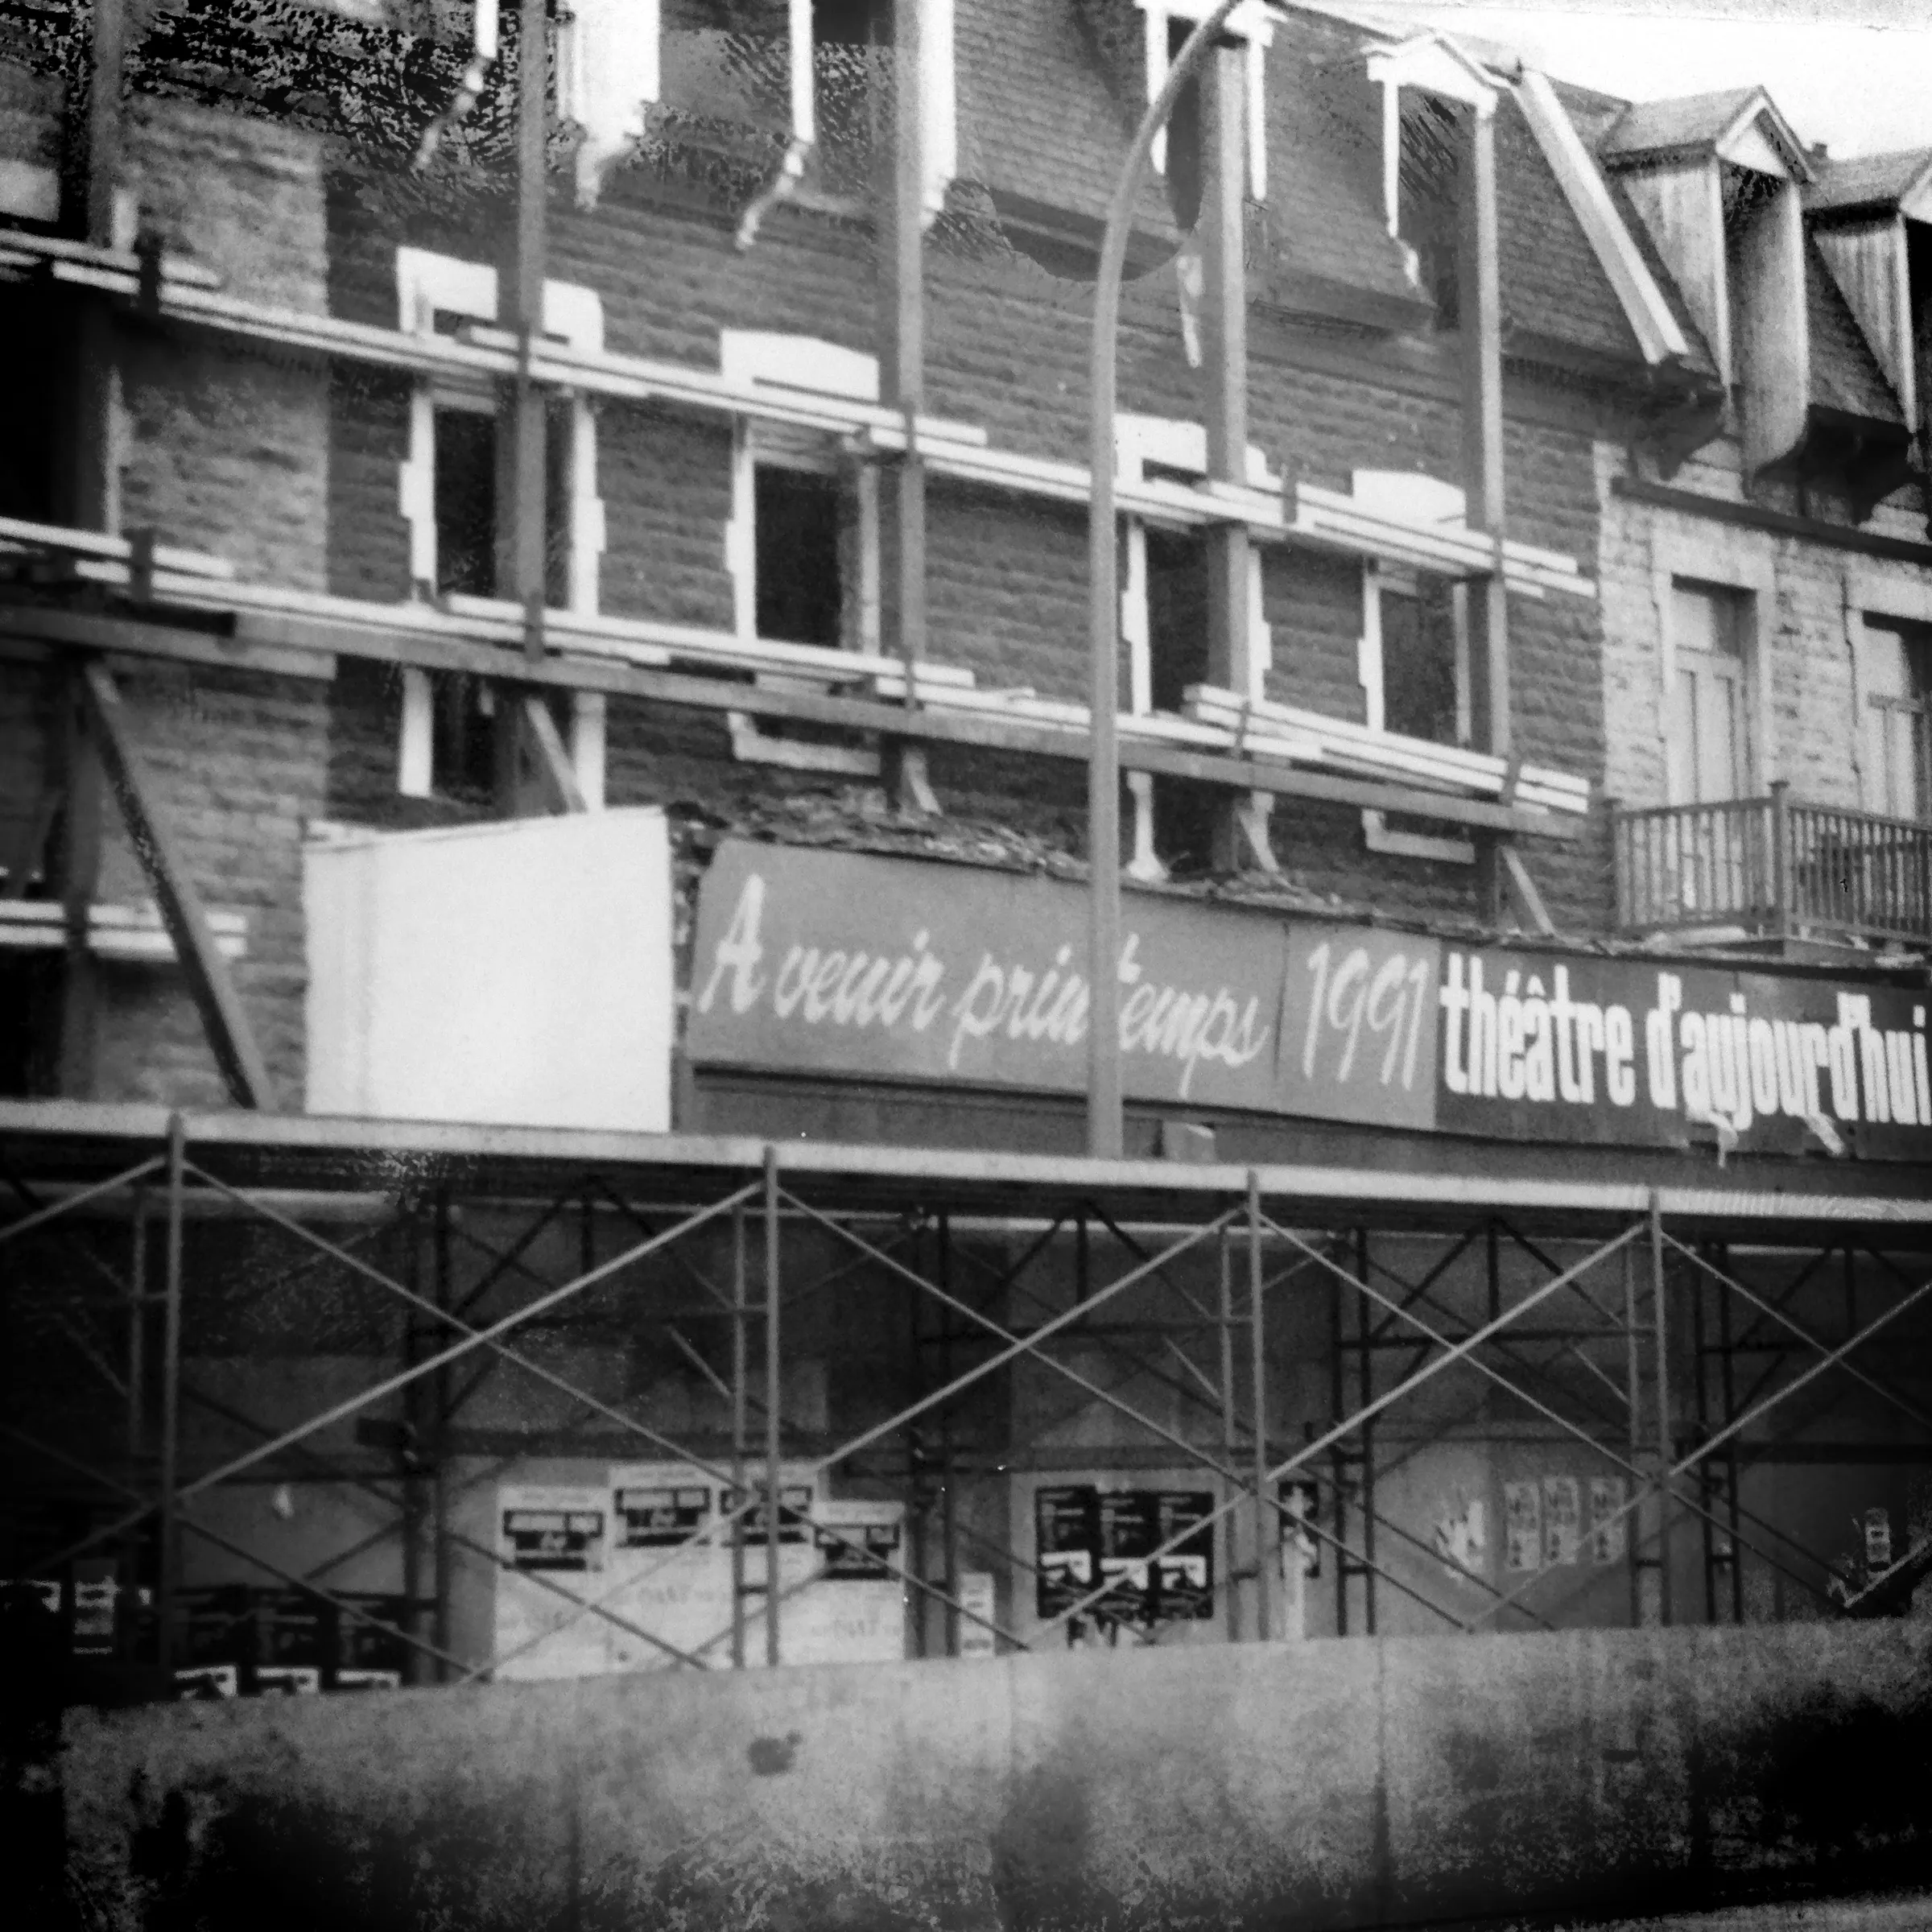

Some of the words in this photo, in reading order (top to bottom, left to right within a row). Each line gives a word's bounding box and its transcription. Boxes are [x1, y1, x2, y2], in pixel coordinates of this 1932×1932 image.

[698, 872, 767, 1015] A
[774, 927, 947, 1031] venir
[1302, 941, 1430, 1092] 1991
[1439, 952, 1636, 1108] théâtre
[1645, 971, 1931, 1159] d'aujourd'hui
